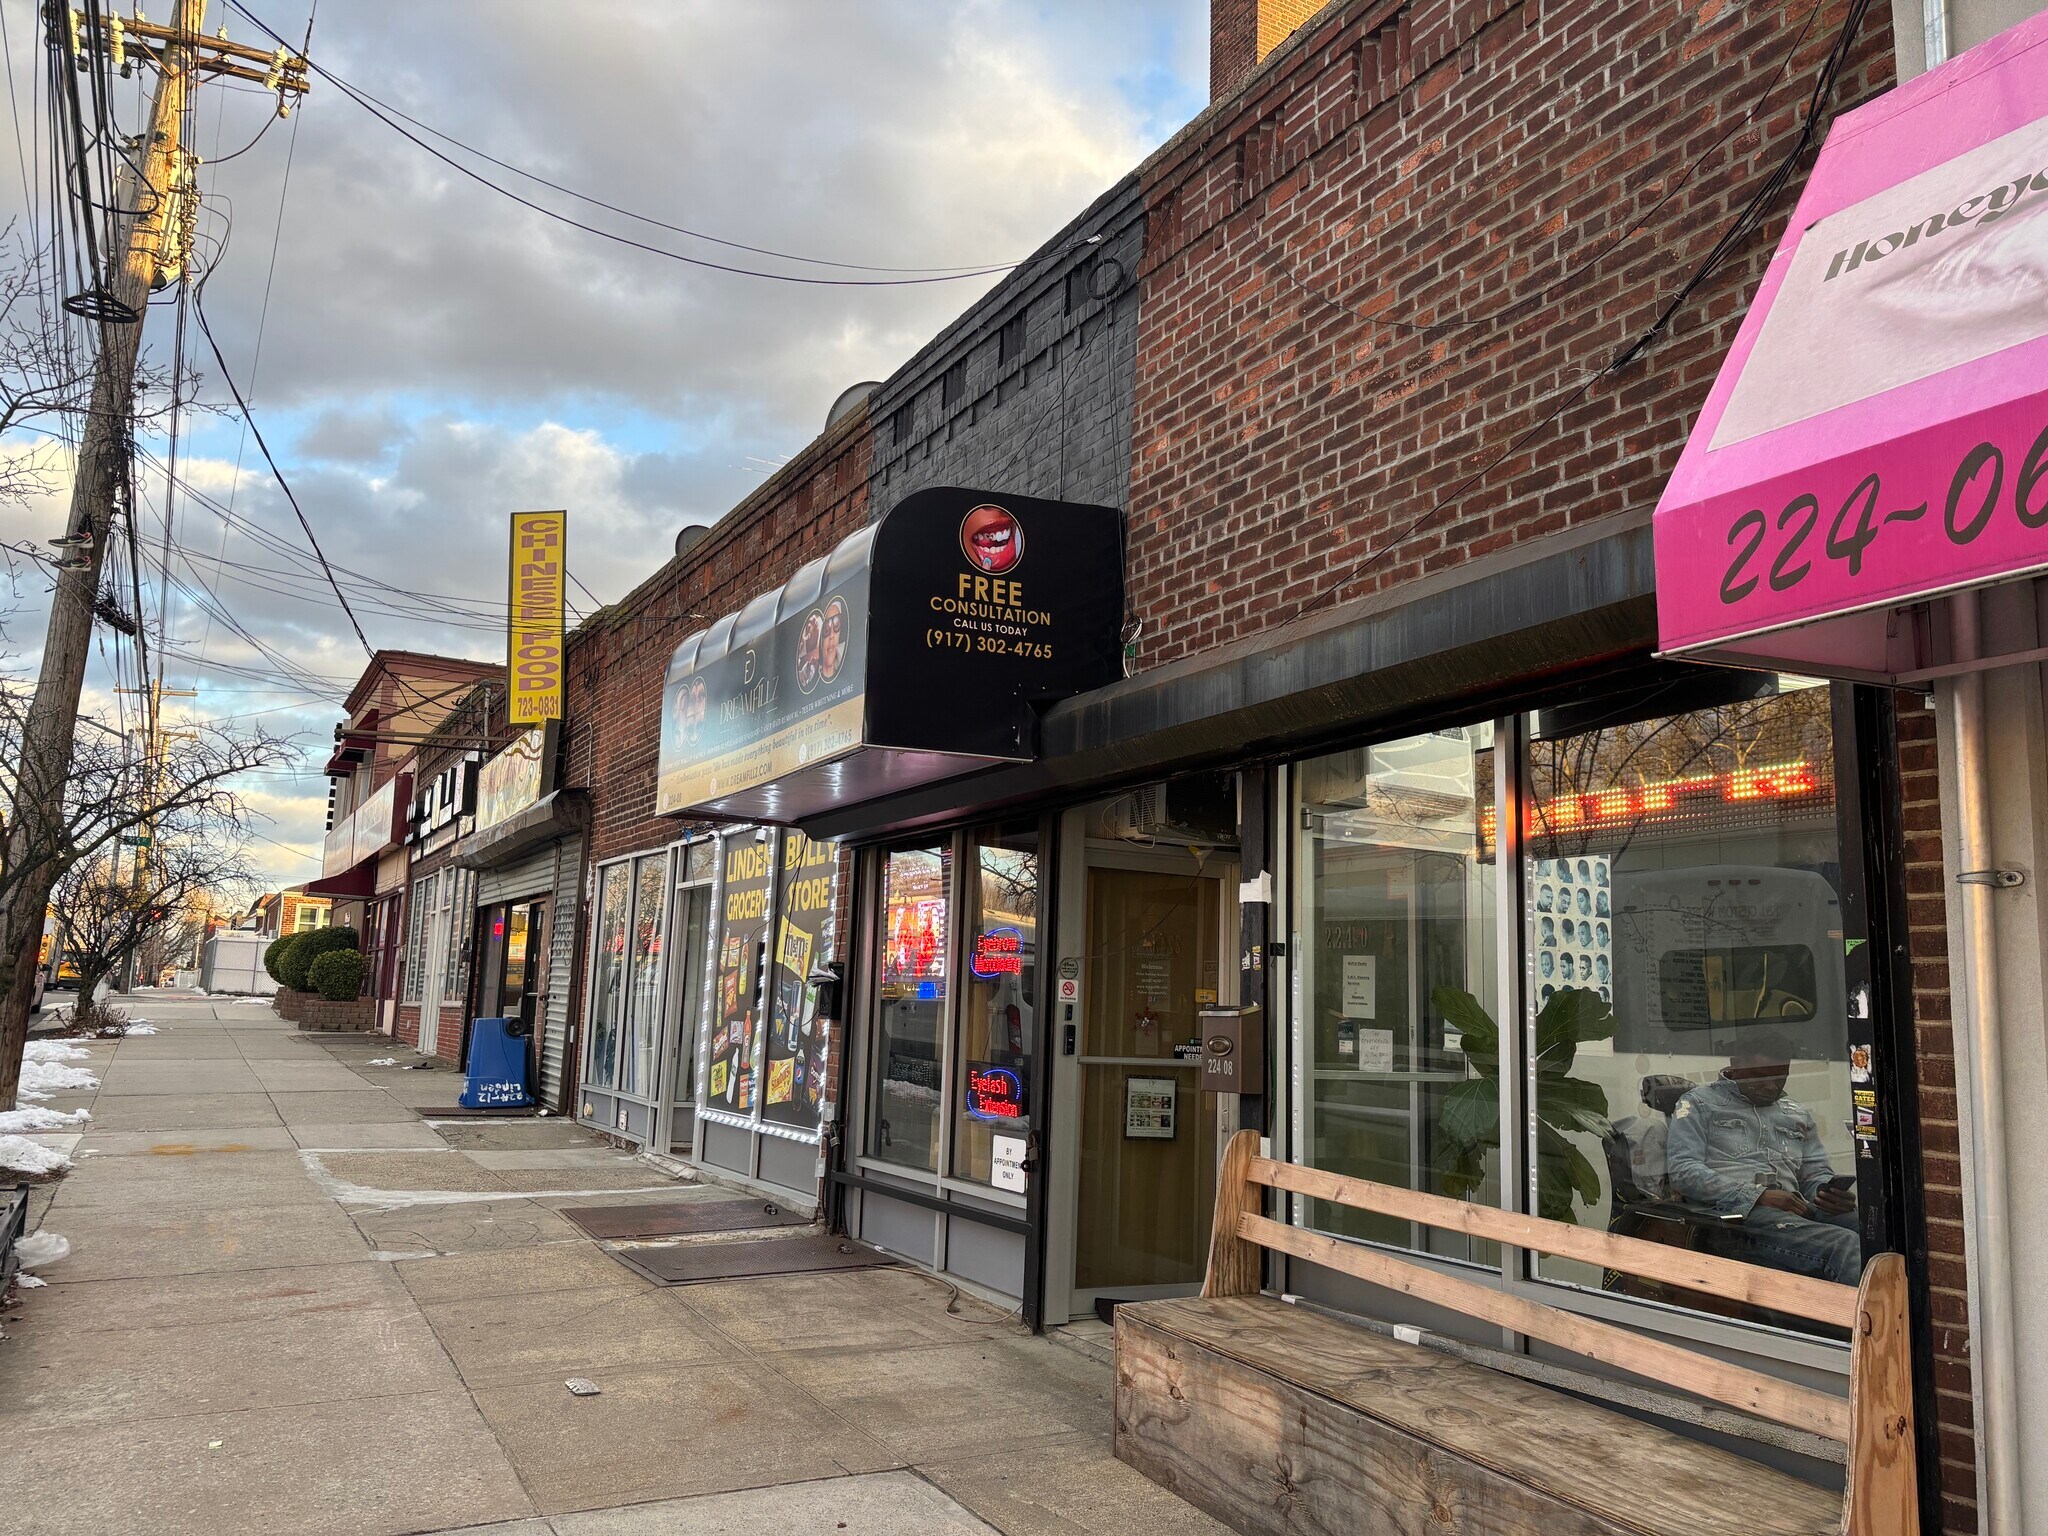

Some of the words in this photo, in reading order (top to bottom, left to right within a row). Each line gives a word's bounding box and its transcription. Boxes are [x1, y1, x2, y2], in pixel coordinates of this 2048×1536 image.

[520, 519, 559, 620] CHINESE
[958, 573, 1022, 607] FREE
[930, 596, 1051, 626] CONSULTATION
[953, 618, 978, 630] CALL
[981, 622, 993, 632] US
[995, 624, 1028, 637] TODAY
[926, 628, 971, 653] (917)
[977, 636, 1052, 659] 302-4765
[517, 629, 560, 692] FOOD
[517, 696, 560, 717] 723-0831
[726, 843, 772, 883] LINDEN
[785, 834, 836, 871] BULLY
[727, 888, 769, 921] GROCERY
[787, 876, 830, 914] STORE
[977, 934, 1018, 956] Eyebrow
[1207, 1058, 1221, 1075] 224
[1223, 1060, 1233, 1076] 08
[970, 1070, 1008, 1098] Eyelash
[979, 1094, 1019, 1119] Extension
[1005, 1147, 1013, 1156] BY
[1001, 1170, 1016, 1181] ONLY
